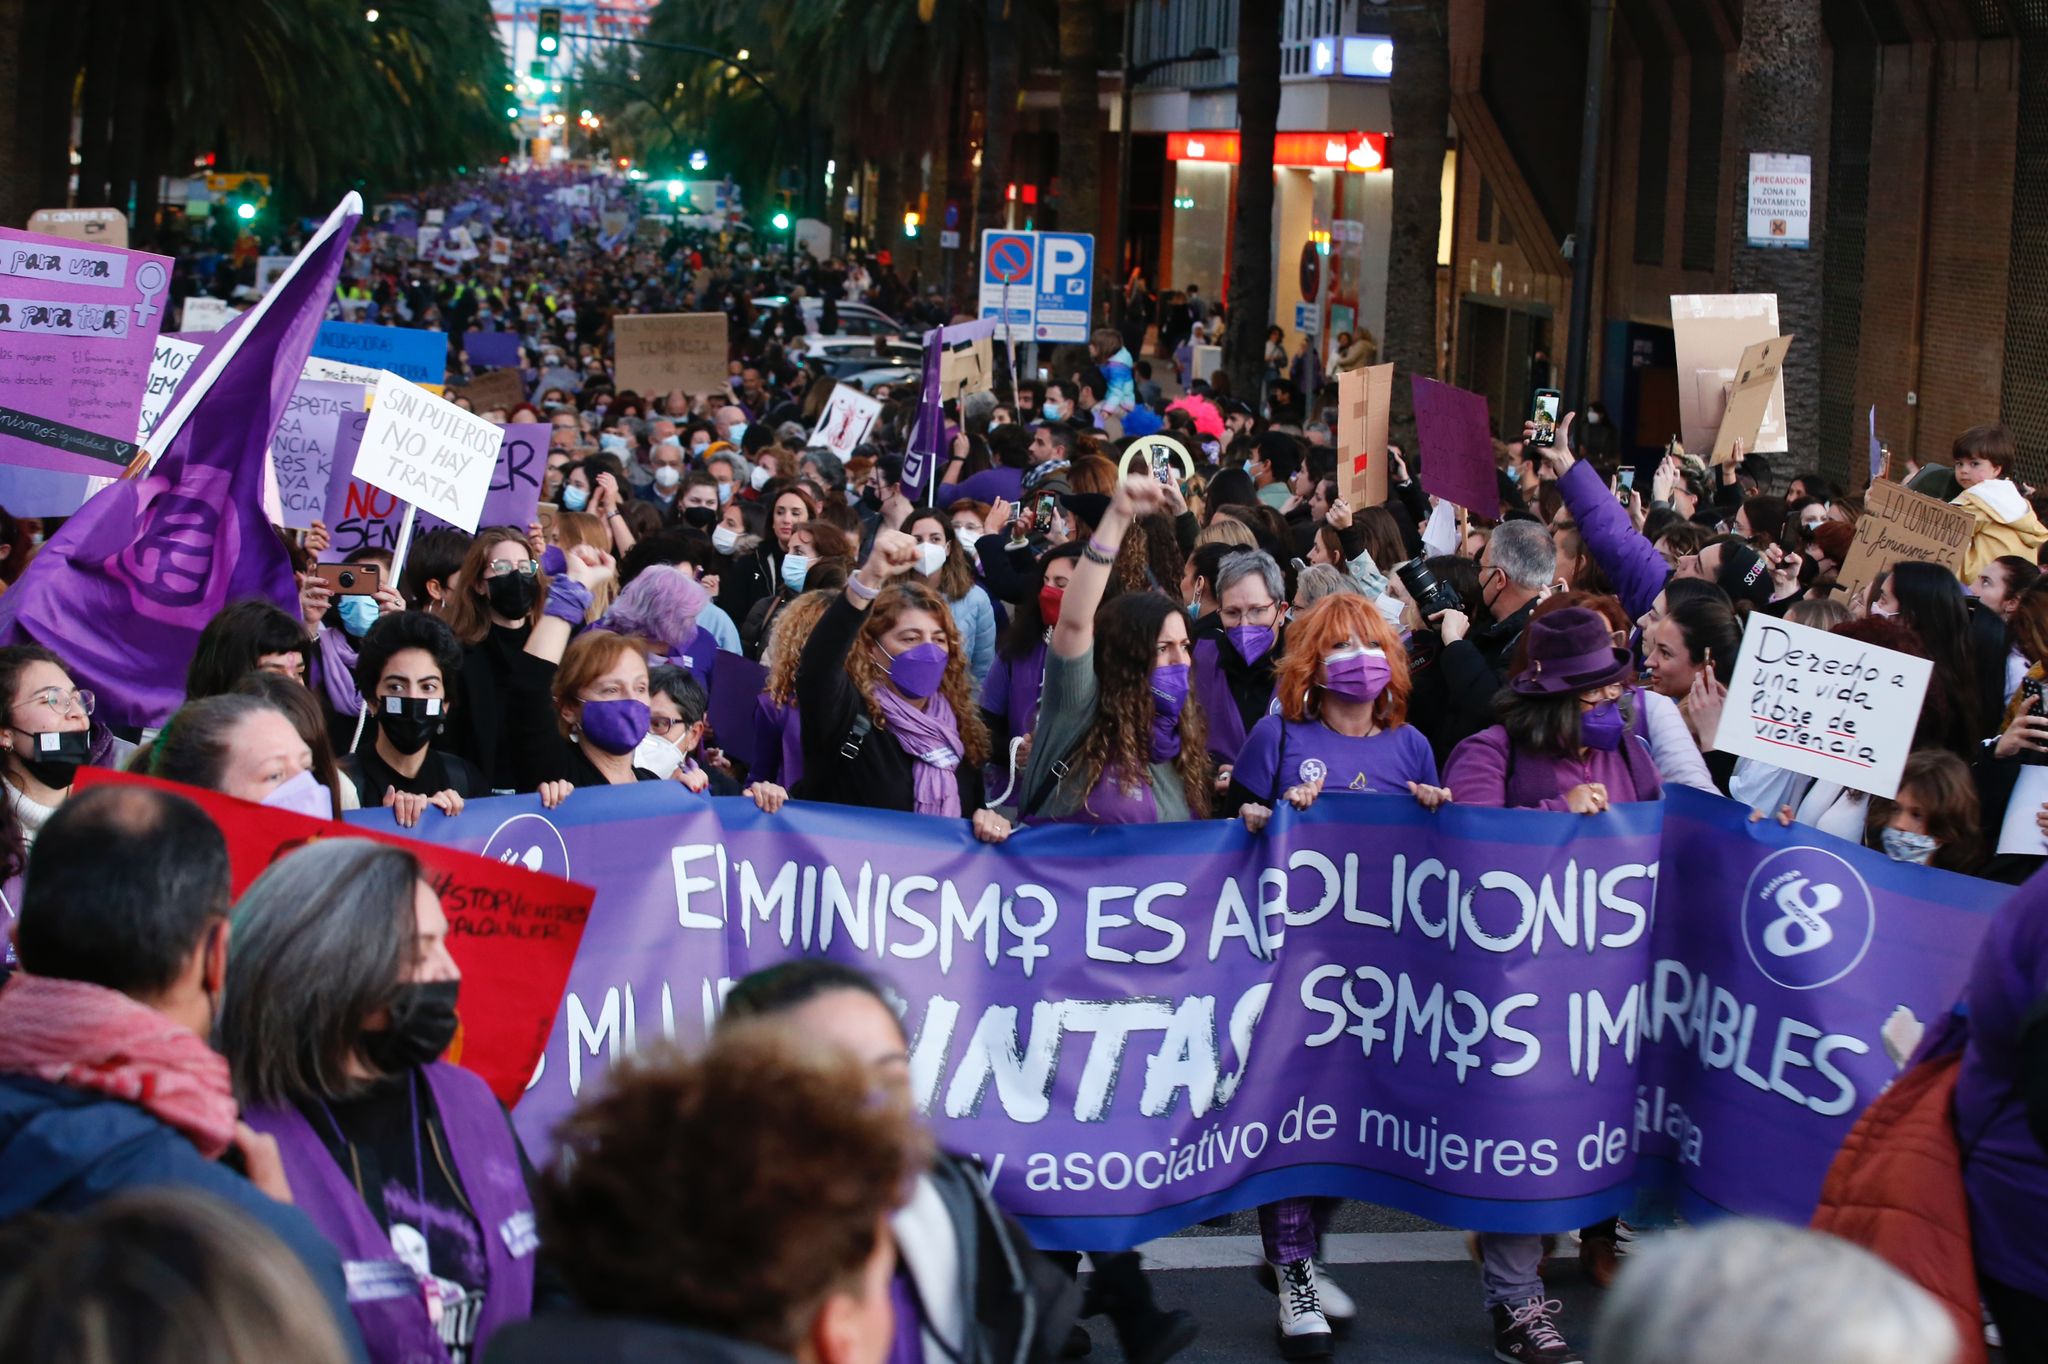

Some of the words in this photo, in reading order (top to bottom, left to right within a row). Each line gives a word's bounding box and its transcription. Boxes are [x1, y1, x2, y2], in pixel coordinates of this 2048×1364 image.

[1750, 208, 1808, 217] FITOSANITARIO
[1753, 197, 1806, 207] TRATAMIENTO
[1762, 187, 1784, 196] ZONA
[10, 251, 62, 274] para
[69, 258, 110, 278] una
[20, 304, 73, 330] para
[77, 303, 127, 335] todas
[383, 388, 418, 419] SIN
[418, 403, 500, 459] PUTEROS
[381, 420, 427, 457] NO
[431, 444, 474, 479] HAY
[387, 455, 461, 512] TRATA
[1853, 519, 1872, 545] AL
[1866, 527, 1935, 559] feminismo
[1882, 489, 1906, 524] LO
[1903, 498, 1969, 549] CONTRARIO
[1754, 625, 1880, 681] Derecho
[1891, 674, 1905, 688] a
[1752, 667, 1800, 694] una
[1815, 679, 1874, 710] vida
[1751, 689, 1813, 725] libre
[1828, 708, 1857, 735] de
[1754, 719, 1878, 763] violencia
[1086, 881, 1189, 964] ES
[1300, 963, 1542, 1084] SOMOS
[1024, 1120, 1269, 1192] asociativo
[1278, 1096, 1338, 1145] de
[1358, 1105, 1559, 1177] mujeres
[1576, 1120, 1628, 1173] de
